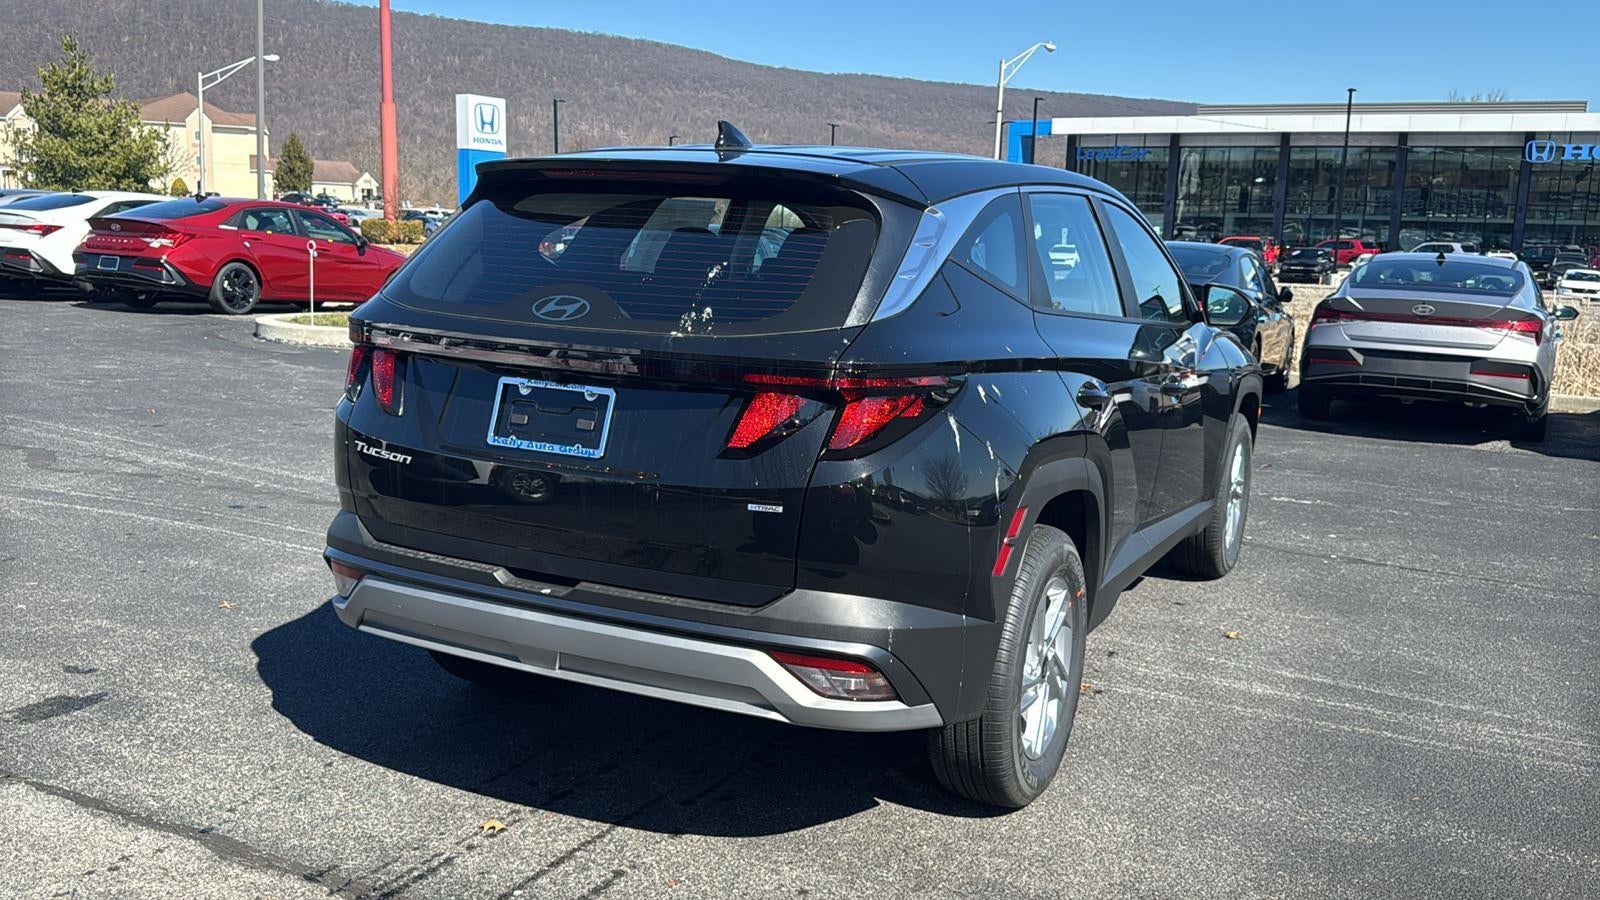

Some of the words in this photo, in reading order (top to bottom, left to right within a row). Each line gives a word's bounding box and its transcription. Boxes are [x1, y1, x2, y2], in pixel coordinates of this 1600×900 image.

[473, 137, 503, 145] HONDA
[492, 437, 523, 448] Kelly
[527, 441, 555, 452] Auto
[559, 445, 597, 457] Group
